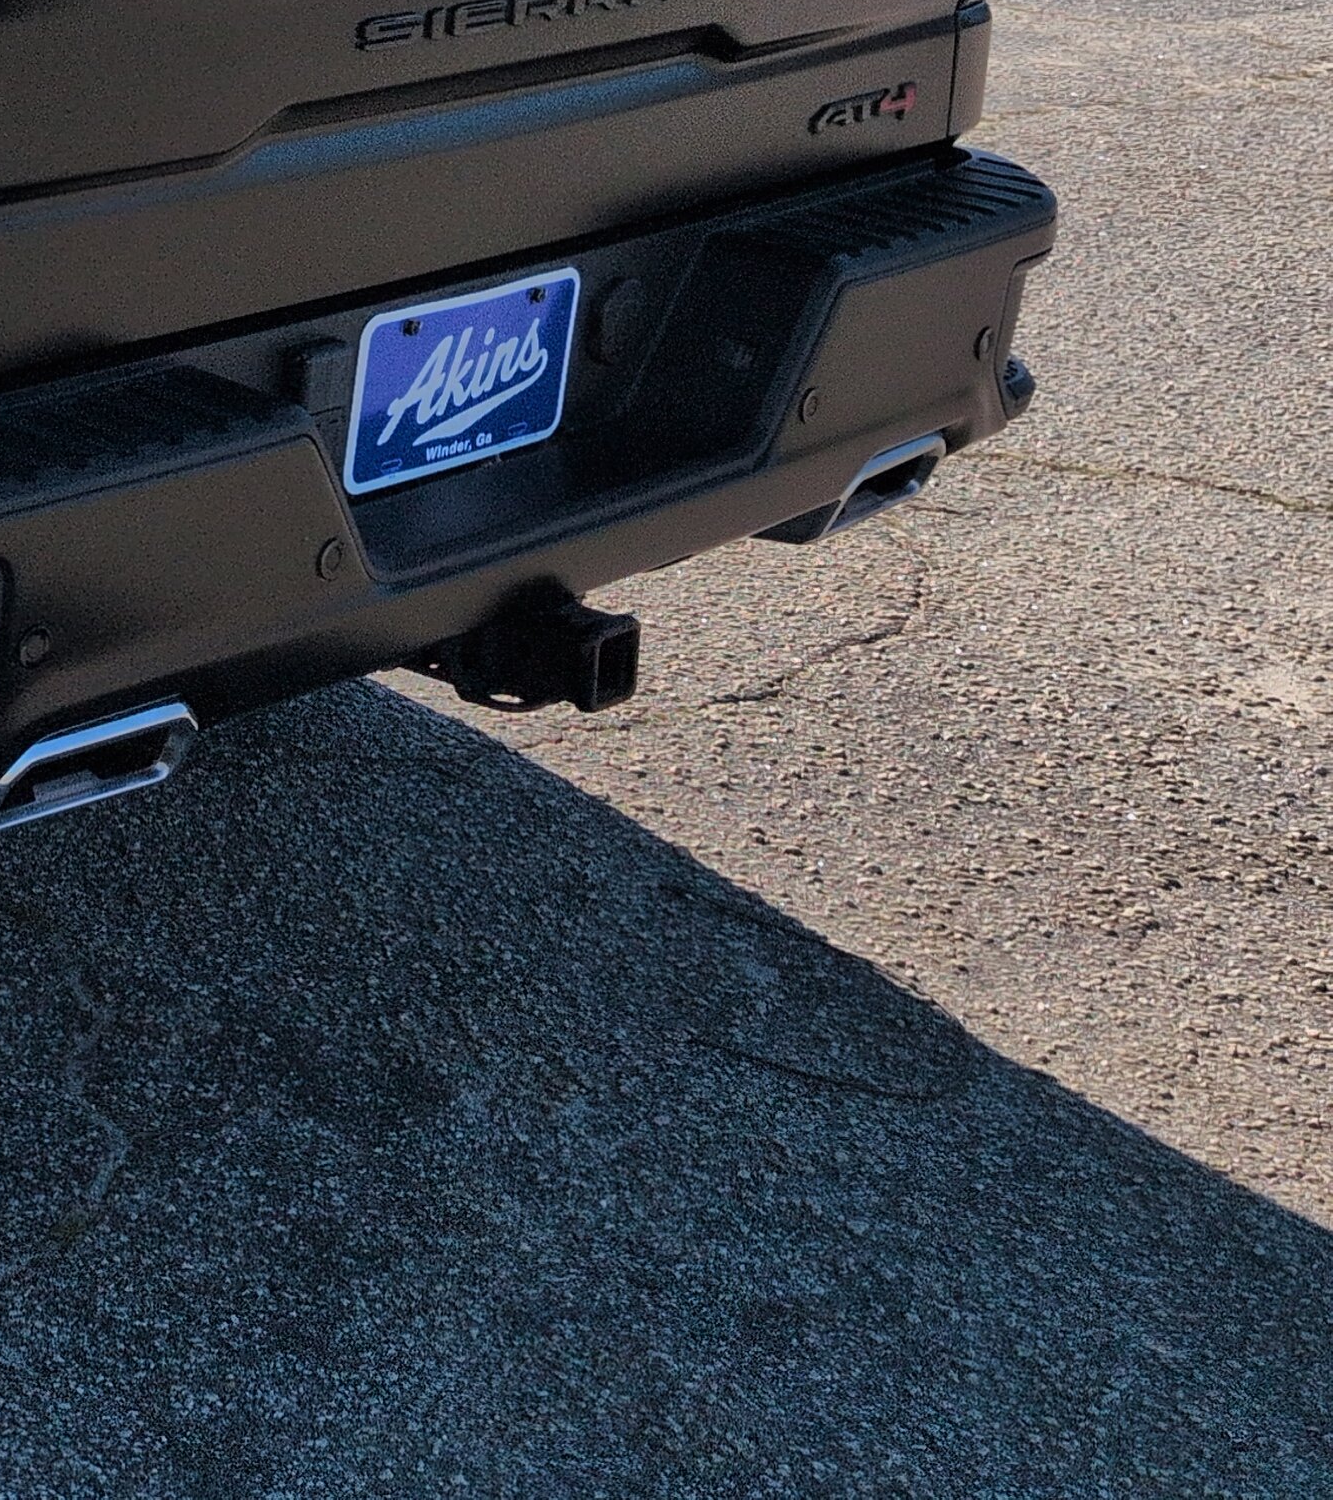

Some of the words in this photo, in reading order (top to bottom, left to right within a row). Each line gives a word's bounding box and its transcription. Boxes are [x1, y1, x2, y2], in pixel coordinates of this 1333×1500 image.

[807, 81, 918, 135] AT4
[376, 317, 549, 447] Akins
[425, 439, 473, 462] Winder,
[475, 432, 493, 447] Ga
